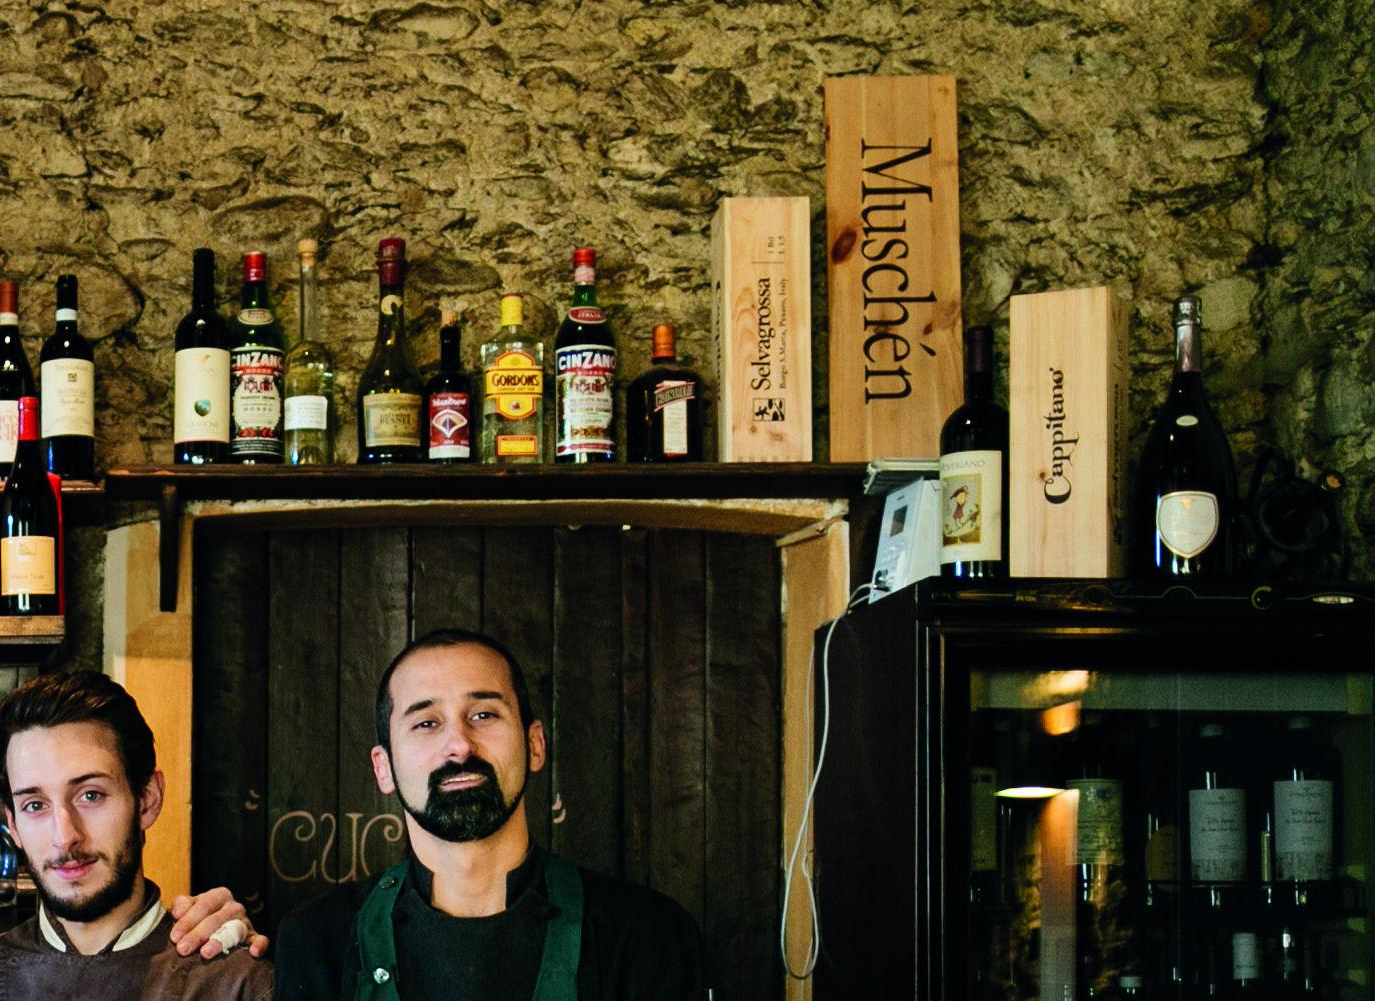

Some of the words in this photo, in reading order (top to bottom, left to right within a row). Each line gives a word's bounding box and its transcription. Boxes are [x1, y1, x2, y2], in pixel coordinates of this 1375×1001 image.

[861, 138, 938, 404] Muschén
[559, 351, 616, 370] CINZANO
[750, 277, 776, 391] Selvagrossa
[1044, 367, 1079, 504] Cappitano
[270, 810, 403, 884] CUC
